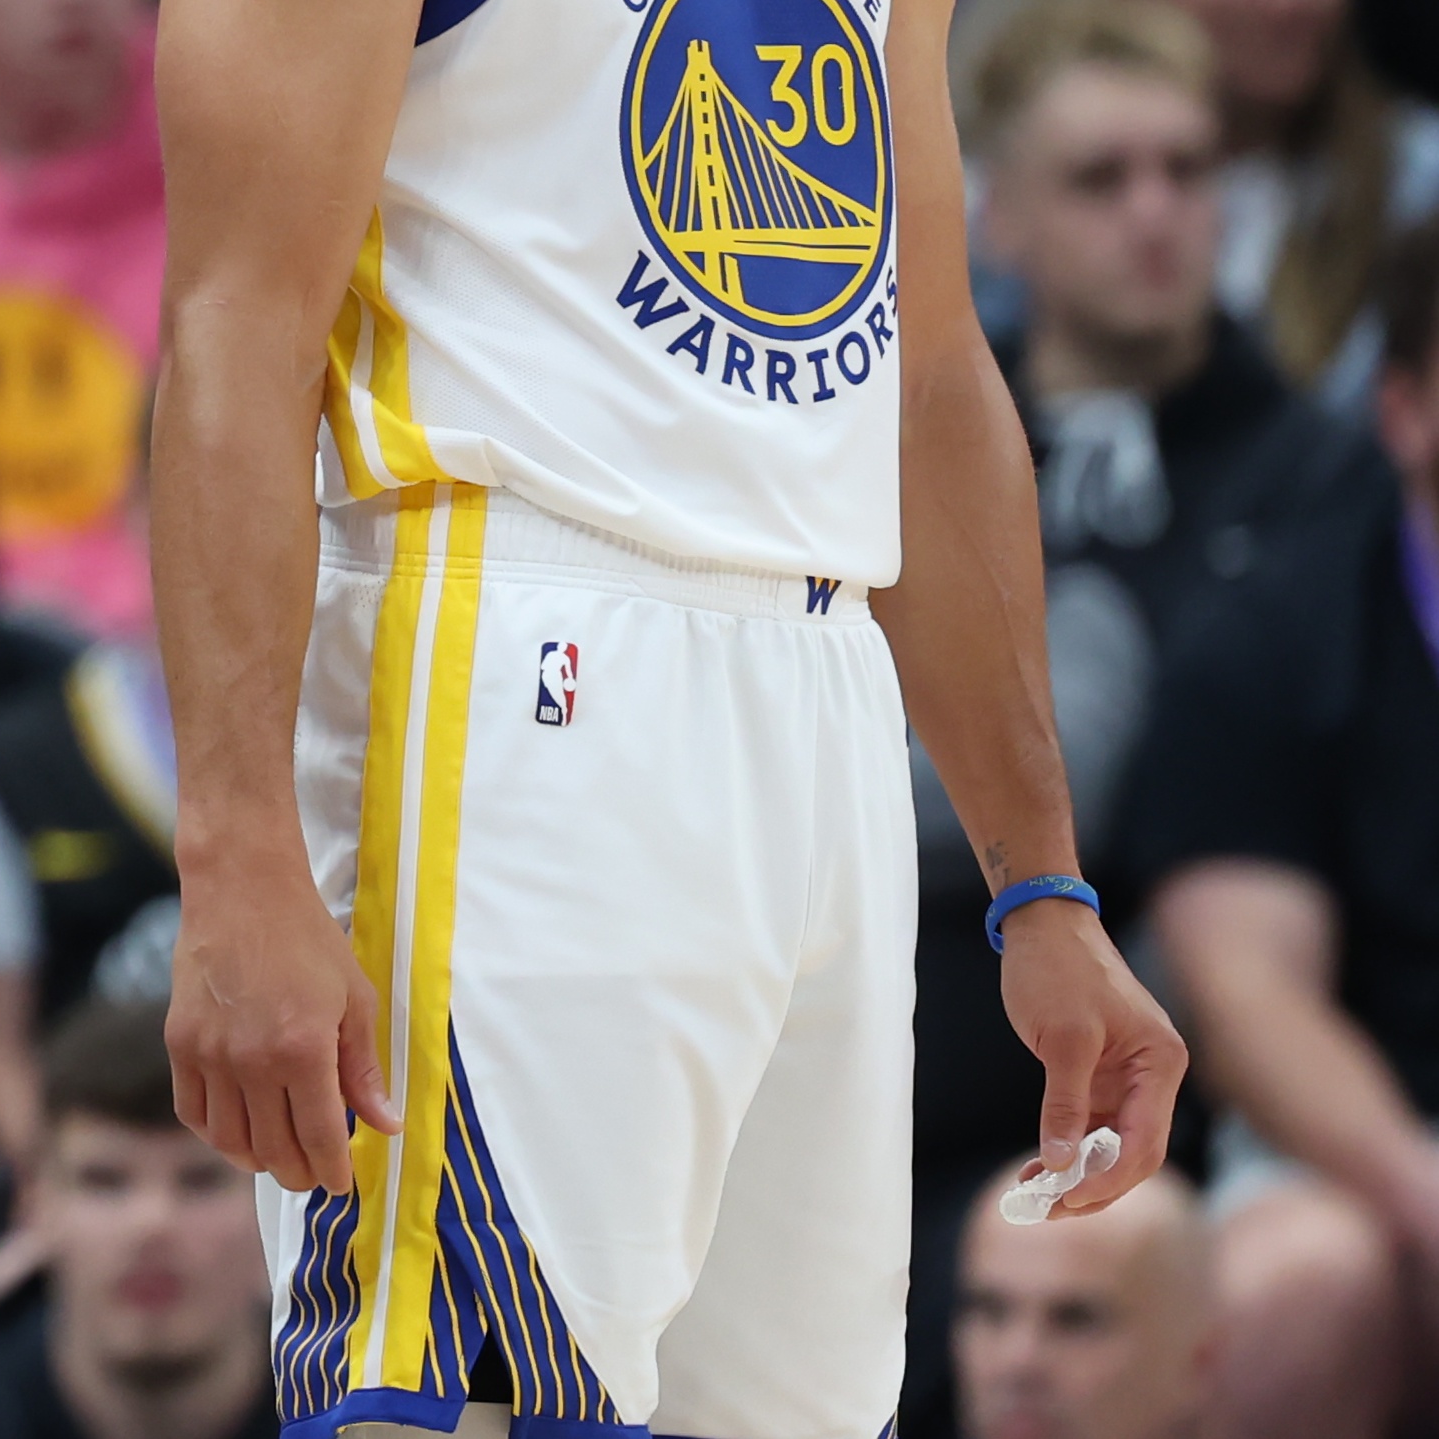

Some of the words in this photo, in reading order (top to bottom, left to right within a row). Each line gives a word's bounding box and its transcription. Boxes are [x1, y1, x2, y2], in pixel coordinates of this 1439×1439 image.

[755, 44, 856, 147] 30
[616, 249, 898, 405] WARRIORS
[539, 705, 559, 723] NBA
